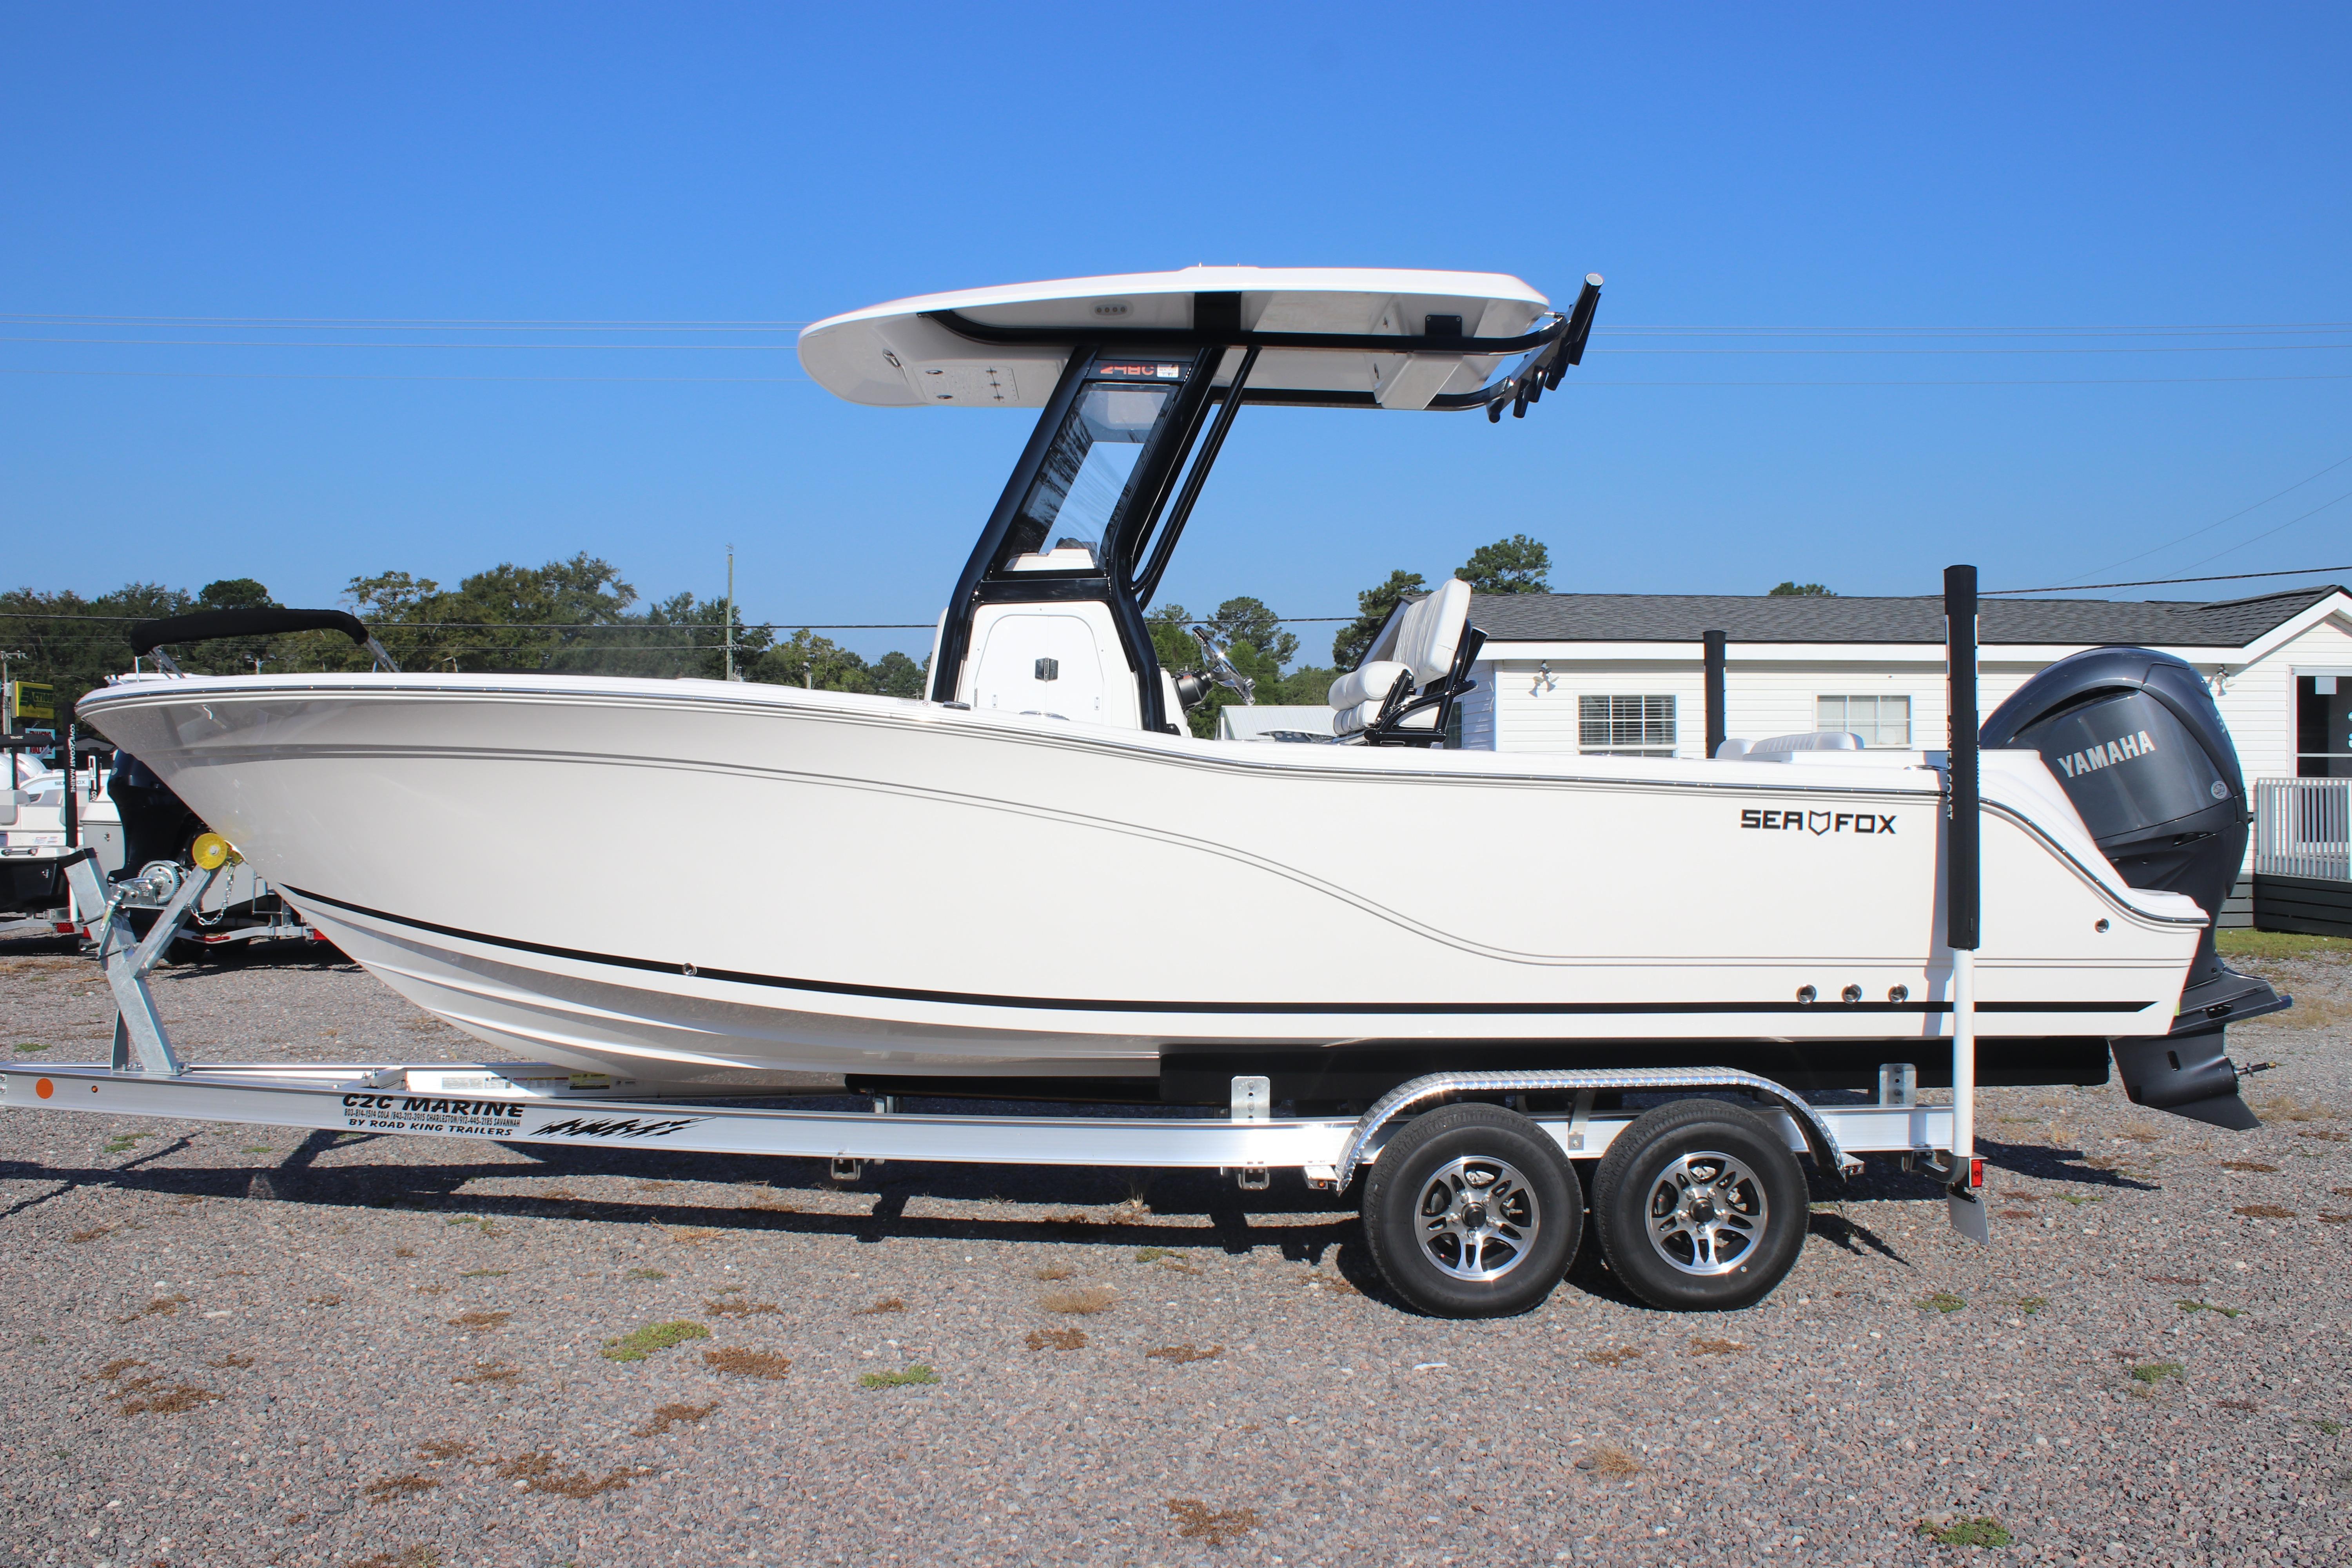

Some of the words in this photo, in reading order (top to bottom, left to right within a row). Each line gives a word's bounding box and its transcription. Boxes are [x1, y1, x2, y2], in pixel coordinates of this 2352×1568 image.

[2057, 730, 2156, 778] YAMAHA
[88, 755, 97, 790] C2C
[1741, 809, 1803, 831] SEA
[1835, 813, 1897, 834] FOX
[343, 1093, 394, 1109] C2C
[402, 1097, 526, 1117] MARINE
[344, 1108, 376, 1117] 803-814-1514
[377, 1110, 389, 1119] COLA
[494, 1118, 521, 1127] SAVANNAH
[370, 1120, 405, 1129] ROAD
[449, 1125, 513, 1136] TRAILERS
